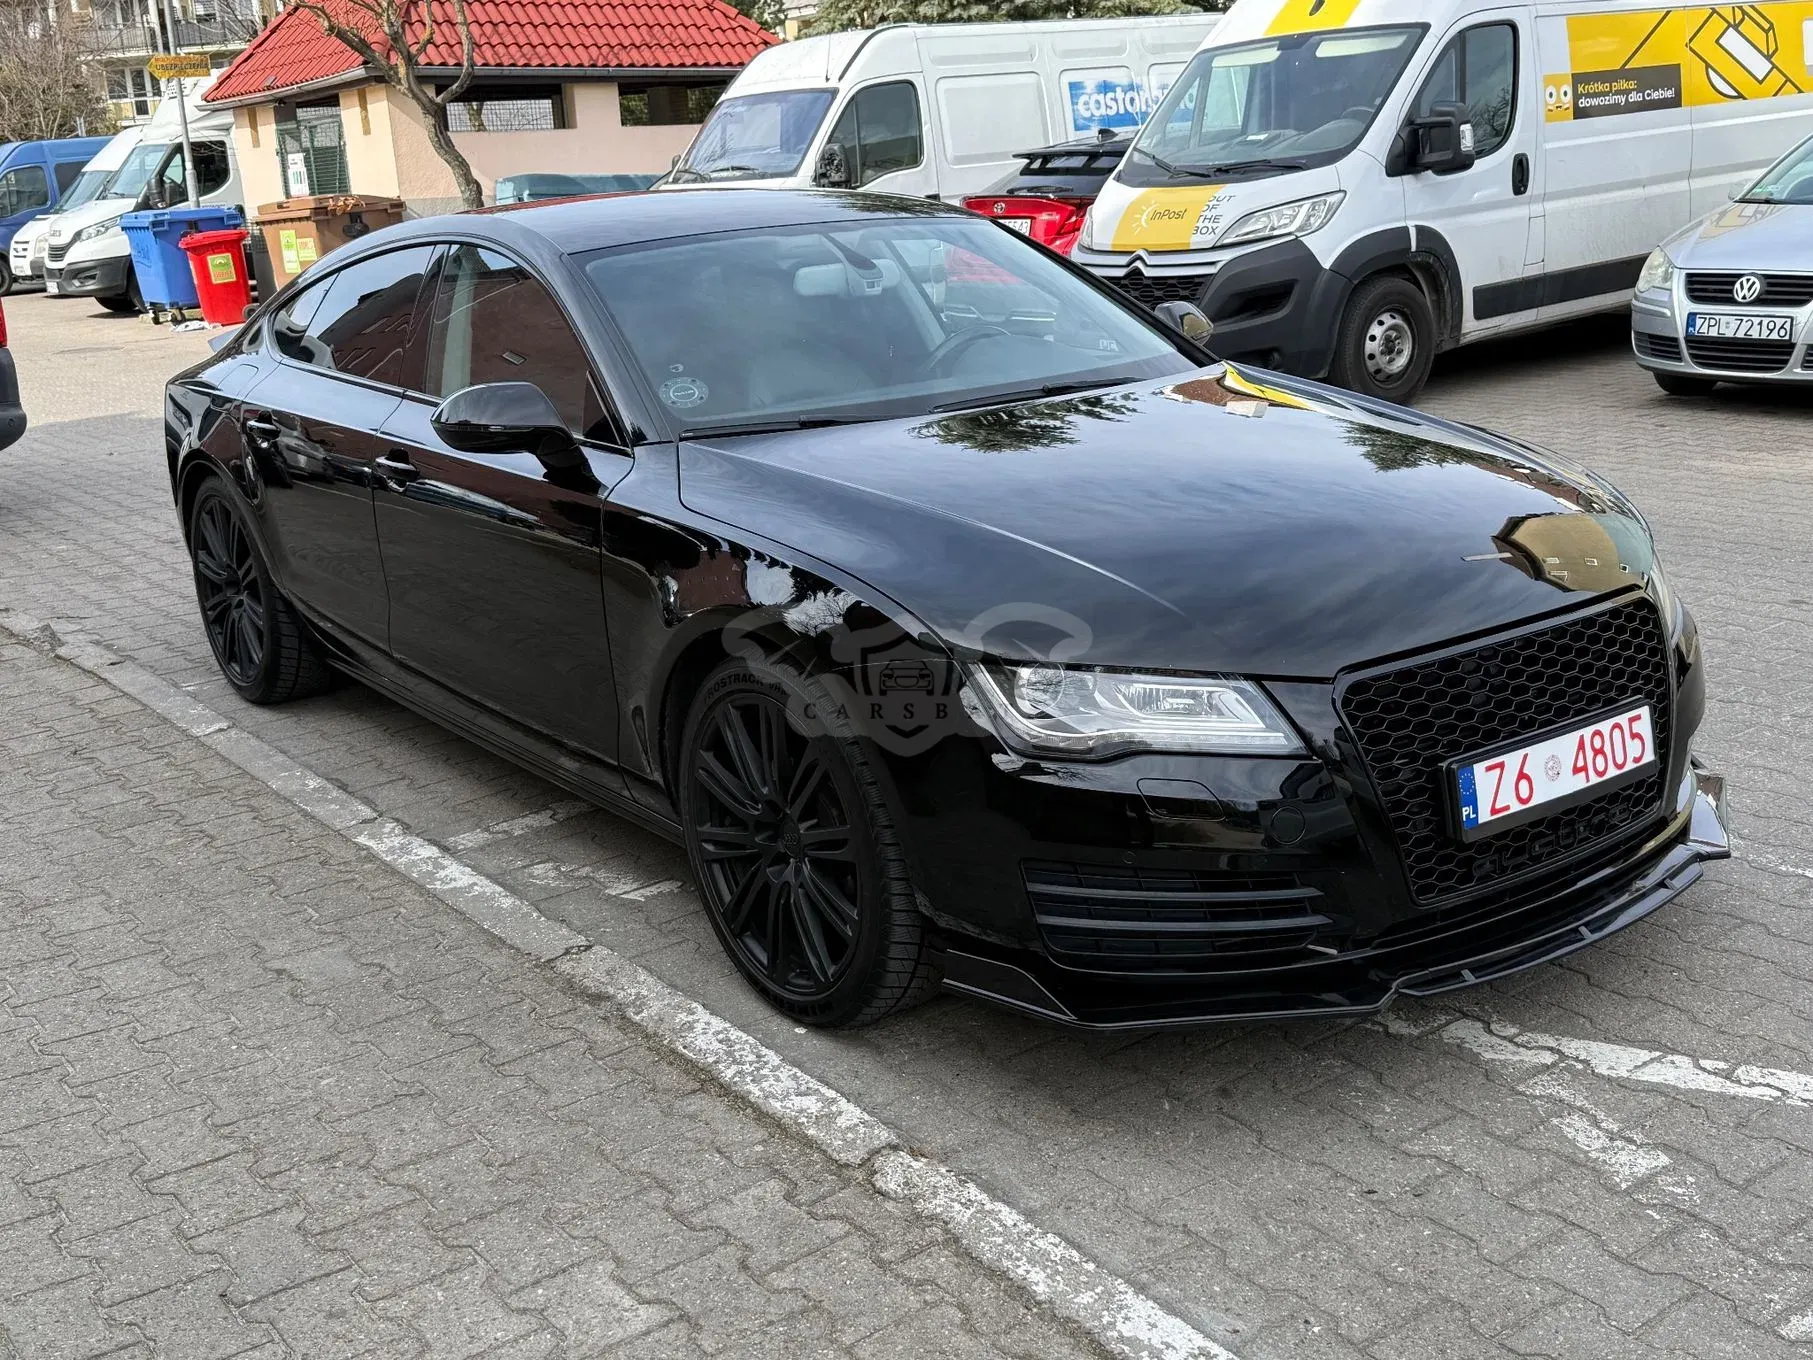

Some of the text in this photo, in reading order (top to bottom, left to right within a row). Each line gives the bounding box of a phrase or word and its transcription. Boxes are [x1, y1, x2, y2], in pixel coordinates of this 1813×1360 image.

[1578, 80, 1637, 94] Krótka piłka:
[1578, 87, 1675, 107] dowozimy dla Ciebie!
[1150, 208, 1187, 221] InPost
[1697, 316, 1788, 339] ZPL 72196
[1484, 713, 1646, 817] Z6 4805
[1462, 805, 1477, 822] PL
